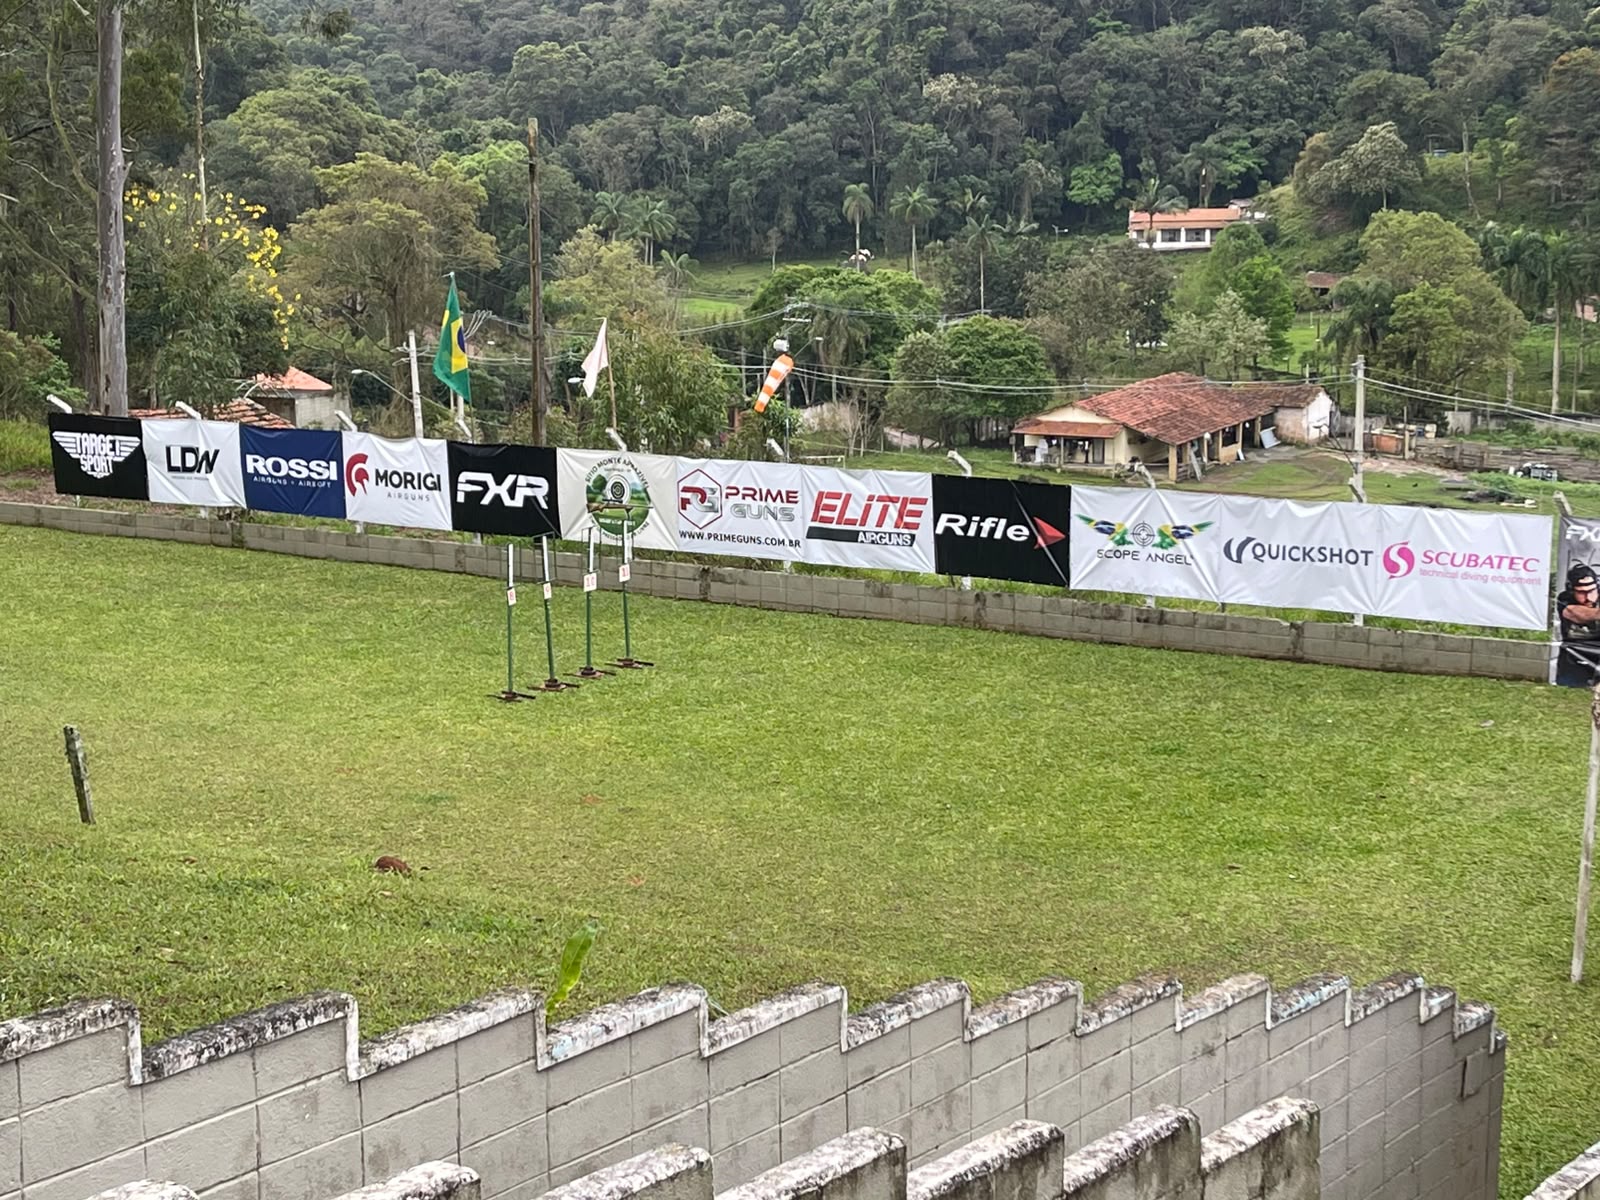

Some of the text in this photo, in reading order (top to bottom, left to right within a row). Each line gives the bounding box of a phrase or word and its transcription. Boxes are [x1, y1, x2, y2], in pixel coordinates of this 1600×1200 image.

[75, 433, 121, 456] TARGET
[80, 456, 114, 474] SPORT
[165, 445, 220, 474] LDW
[245, 454, 338, 481] ROSSI
[253, 476, 332, 489] AIRGUNS AIRSOFT
[375, 468, 442, 492] MORIGI
[387, 491, 431, 502] AIRGUNS
[456, 471, 549, 510] FXR
[725, 486, 799, 504] PRIME
[730, 503, 795, 522] GUNS
[935, 513, 1030, 542] Rifle
[679, 530, 802, 548] WWW.PRIMEGUNS.COM.BR
[857, 531, 912, 546] AIRGUNS
[1096, 548, 1192, 565] SCOPE ANGEL
[1251, 542, 1374, 567] QUICKSHOT
[1421, 549, 1540, 573] SCUBATEC
[1419, 568, 1542, 586] technical diving equipment
